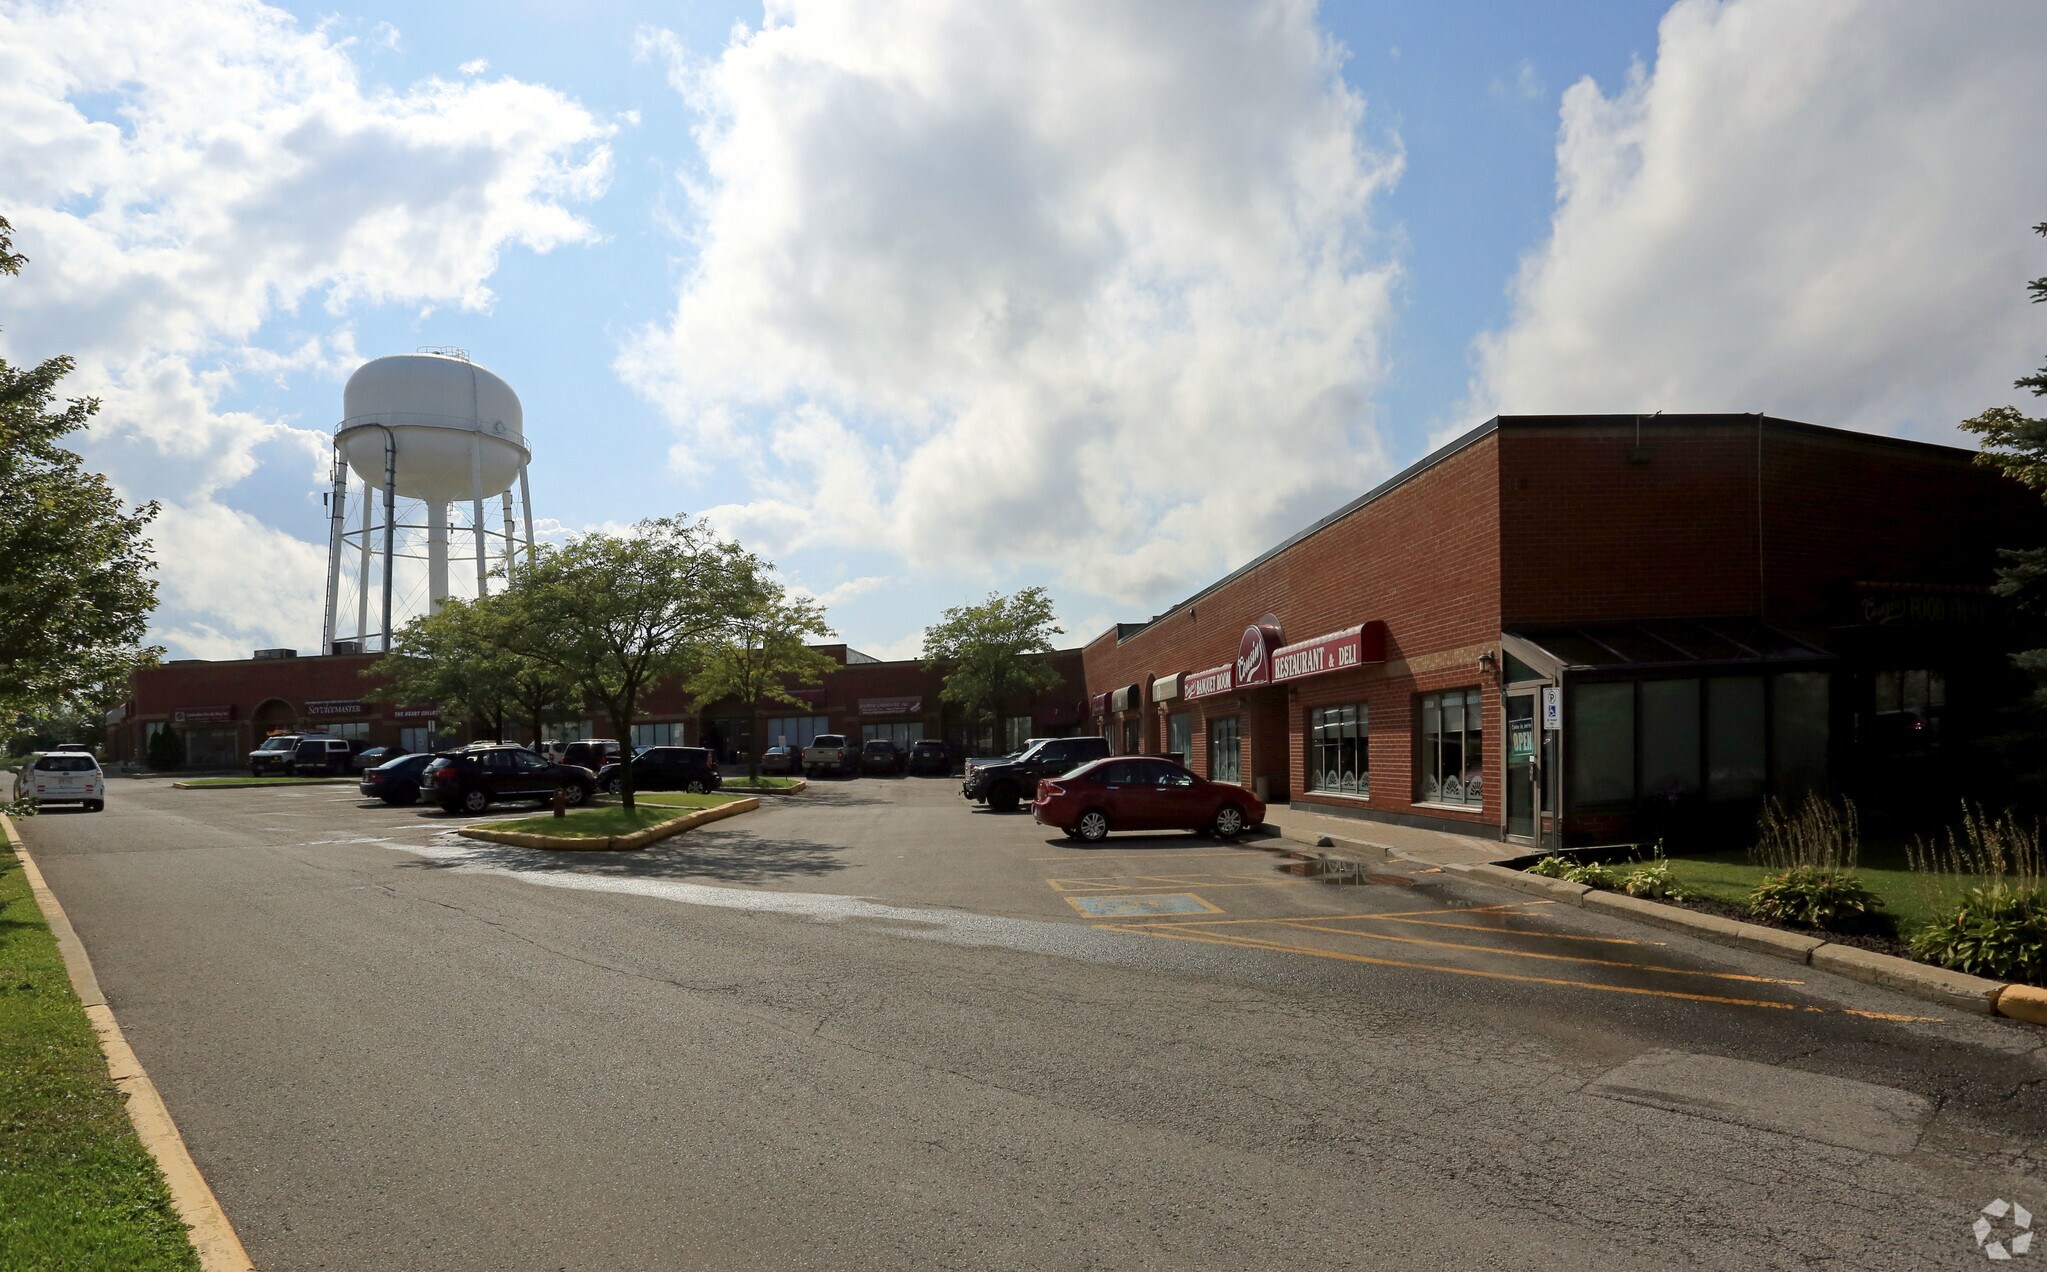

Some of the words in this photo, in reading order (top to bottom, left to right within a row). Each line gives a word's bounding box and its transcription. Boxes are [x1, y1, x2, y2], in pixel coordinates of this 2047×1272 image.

[1274, 646, 1325, 679] RESTAURANT
[1328, 652, 1335, 669] &
[1338, 643, 1357, 666] DELI
[1196, 675, 1216, 696] BANQUET
[1216, 671, 1231, 691] ROOM
[404, 710, 420, 718] HEART
[1512, 731, 1532, 752] OPEN
